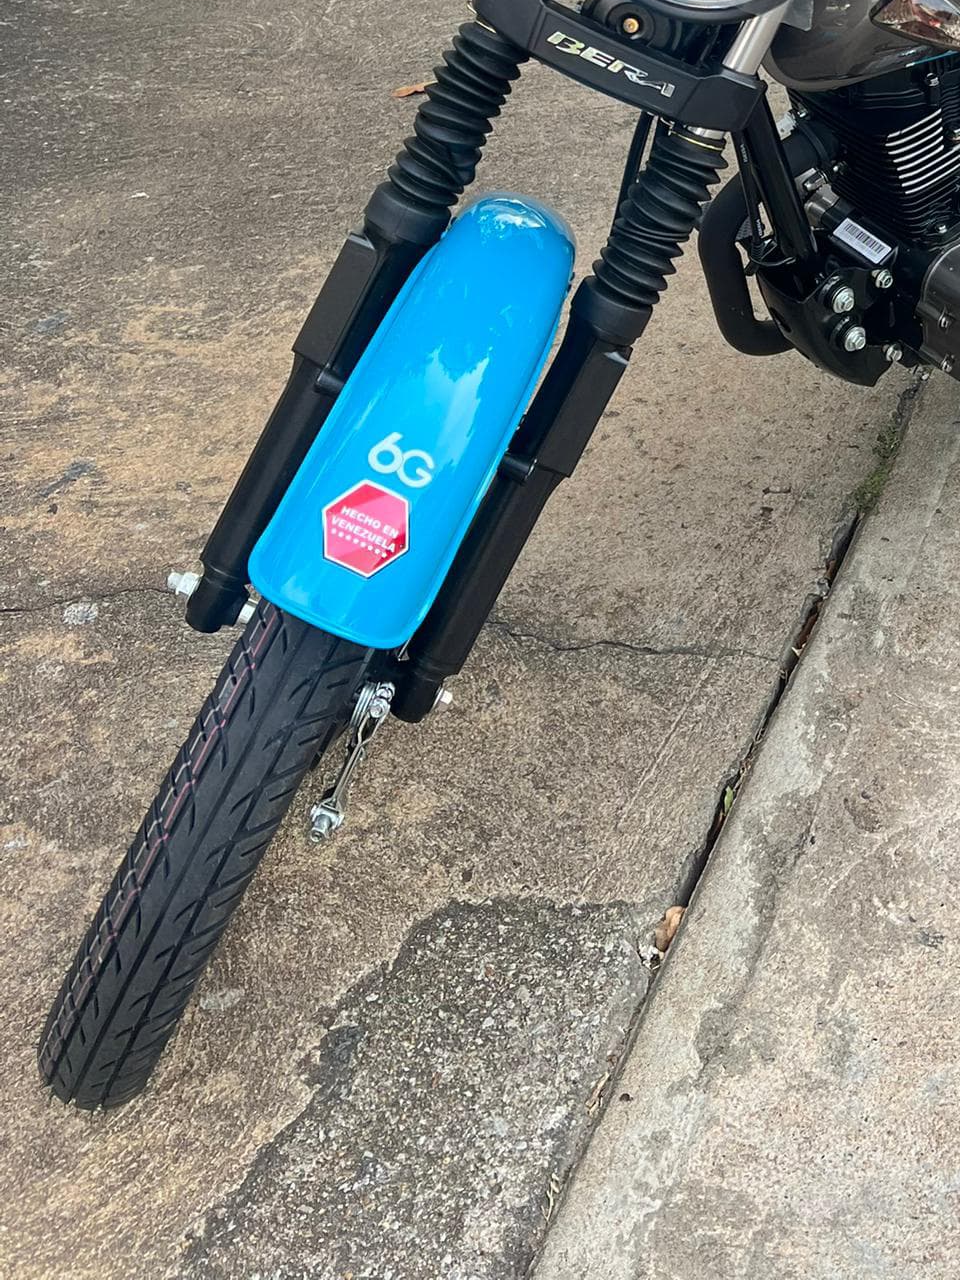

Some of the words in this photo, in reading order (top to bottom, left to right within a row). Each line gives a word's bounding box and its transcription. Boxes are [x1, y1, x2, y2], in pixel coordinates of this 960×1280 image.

[547, 31, 676, 98] BERA
[368, 431, 435, 488] 6G
[331, 516, 397, 553] VENEZUELA
[340, 506, 382, 529] HECHO
[383, 524, 399, 539] EN
